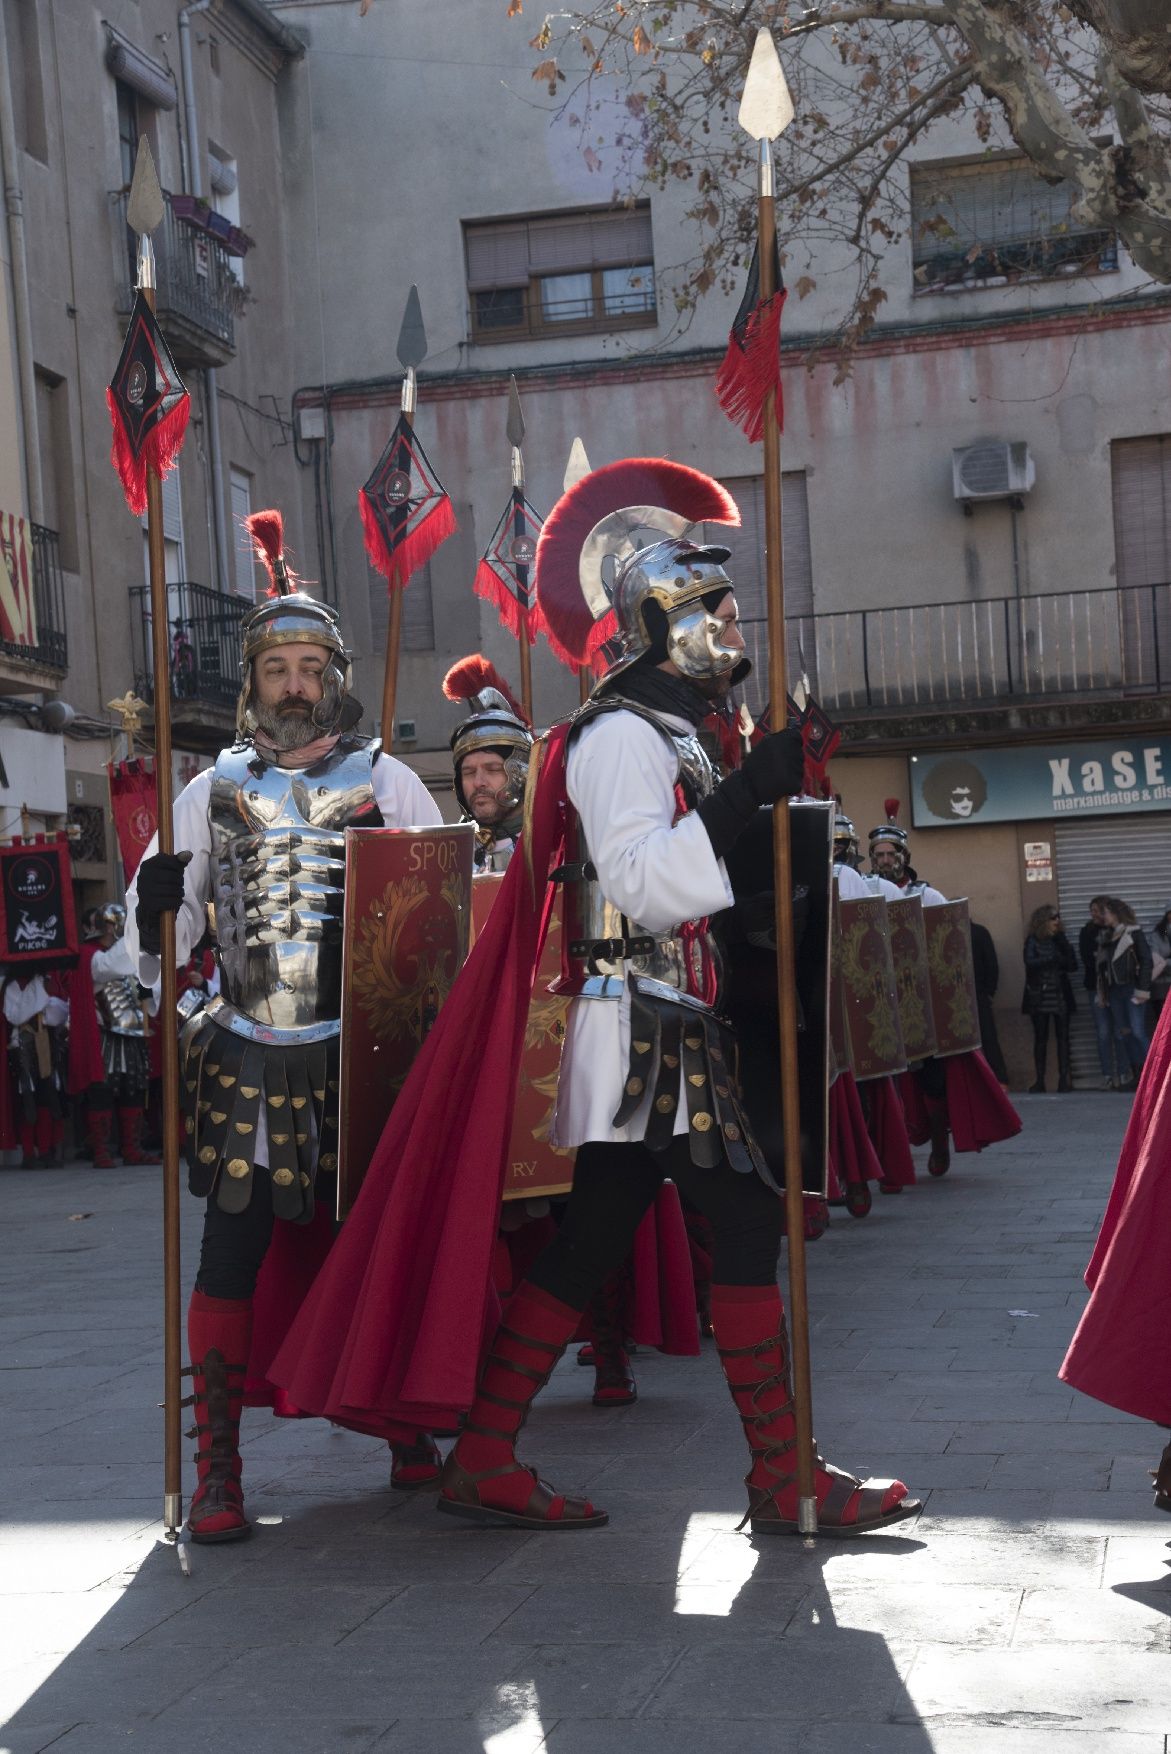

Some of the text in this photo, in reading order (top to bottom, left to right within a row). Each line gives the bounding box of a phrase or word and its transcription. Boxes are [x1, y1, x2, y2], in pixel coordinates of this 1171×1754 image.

[1049, 747, 1165, 796] XaSE
[1052, 789, 1140, 811] marxandatge
[1142, 788, 1152, 801] &
[408, 840, 459, 873] SPQR
[511, 1161, 538, 1177] RV
